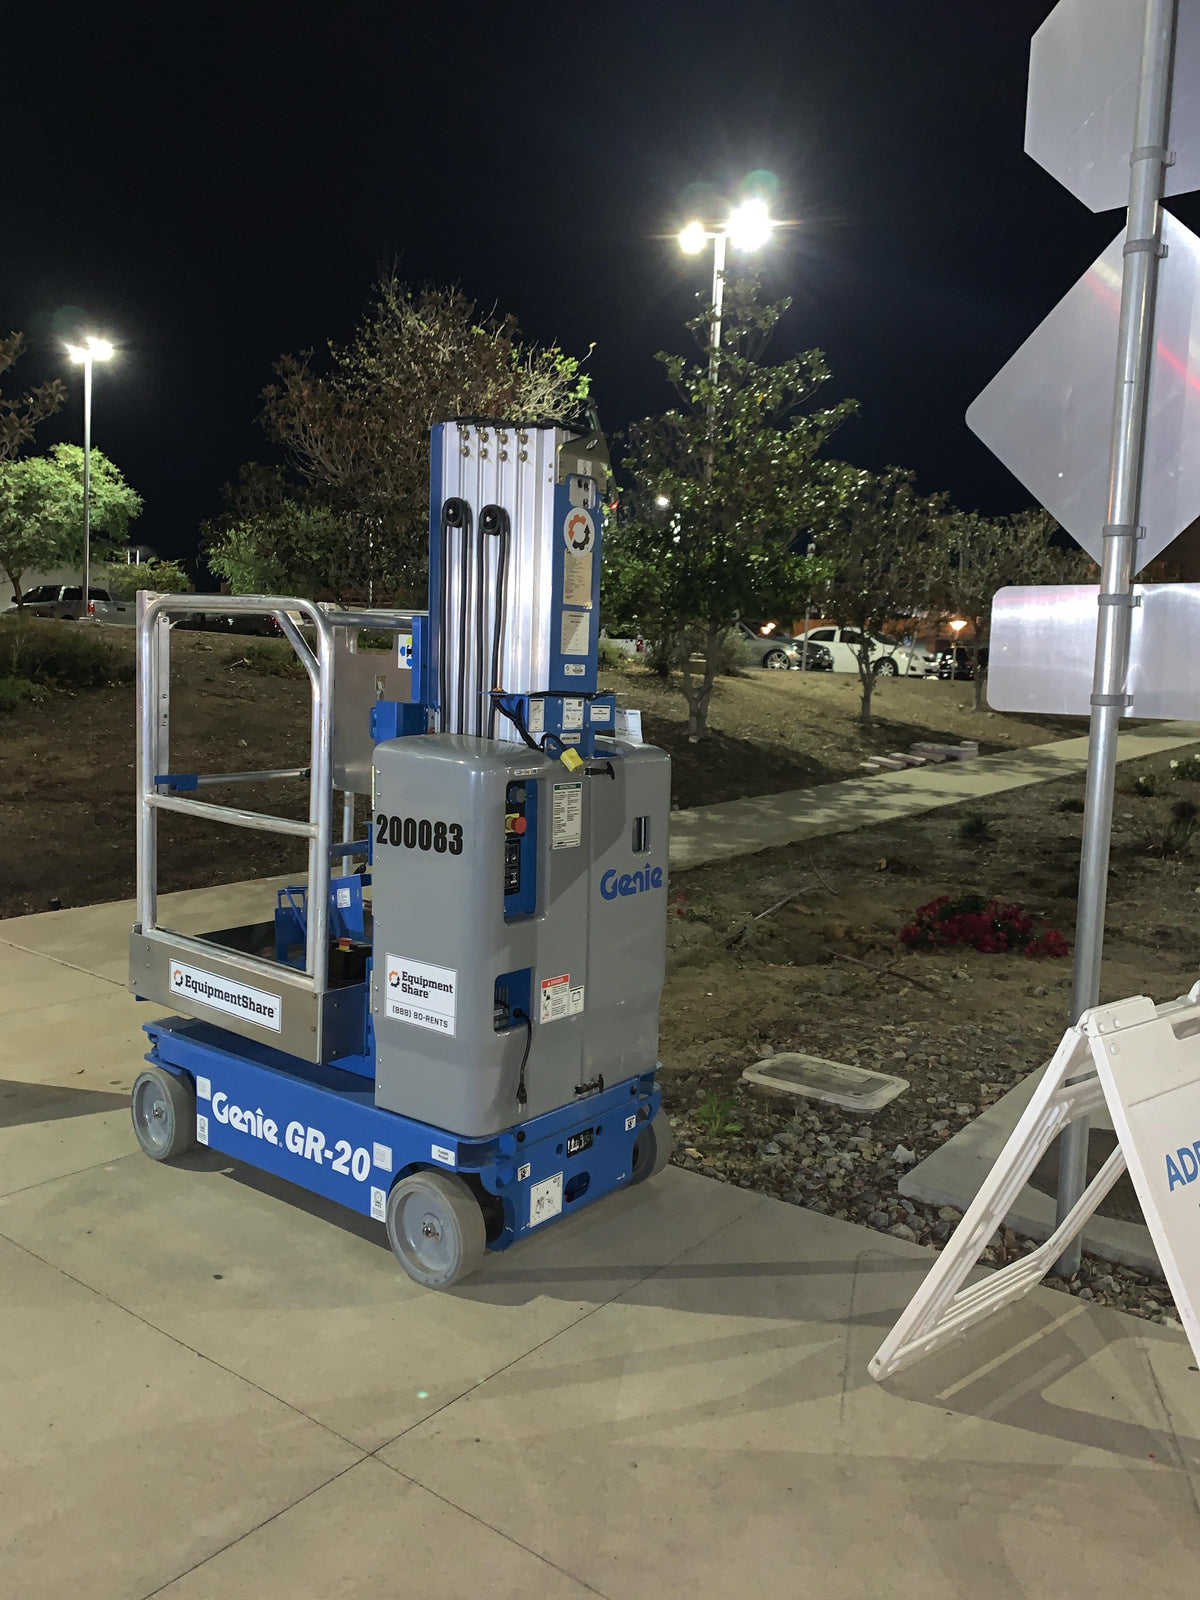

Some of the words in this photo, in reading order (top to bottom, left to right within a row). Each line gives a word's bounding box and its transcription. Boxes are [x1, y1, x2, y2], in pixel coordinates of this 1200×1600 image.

[376, 813, 464, 856] 200083
[600, 862, 663, 901] Genie
[184, 974, 274, 1019] EquipmentShare
[401, 970, 454, 994] Equipment
[401, 982, 429, 999] Share
[392, 1005, 412, 1018] (888)
[413, 1011, 449, 1028] 80-RENTS
[212, 1091, 279, 1146] Genie
[285, 1120, 371, 1182] GR-20
